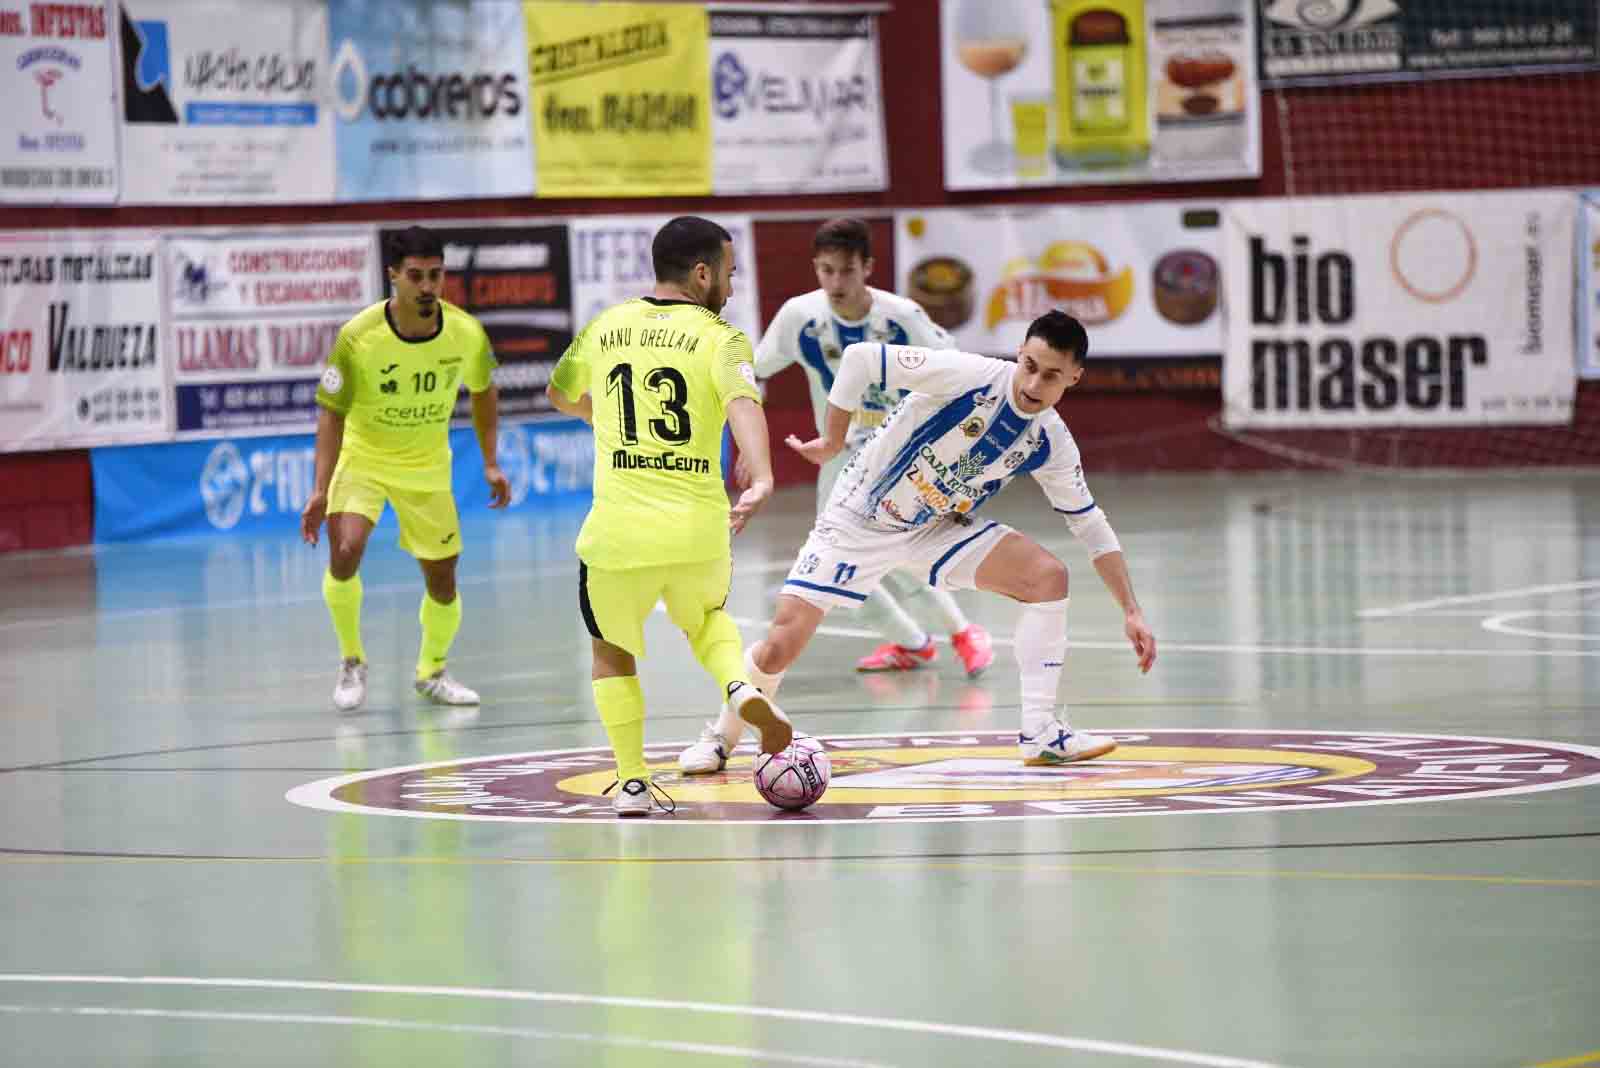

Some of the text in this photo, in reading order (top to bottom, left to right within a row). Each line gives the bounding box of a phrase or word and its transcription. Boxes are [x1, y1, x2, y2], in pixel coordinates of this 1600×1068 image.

[1249, 235, 1356, 325] bio
[600, 326, 700, 355] MANU ORELLANA
[407, 371, 437, 394] 10
[1250, 333, 1489, 411] maser
[605, 362, 692, 447] 13
[918, 443, 950, 479] CAJA
[834, 562, 857, 585] 11
